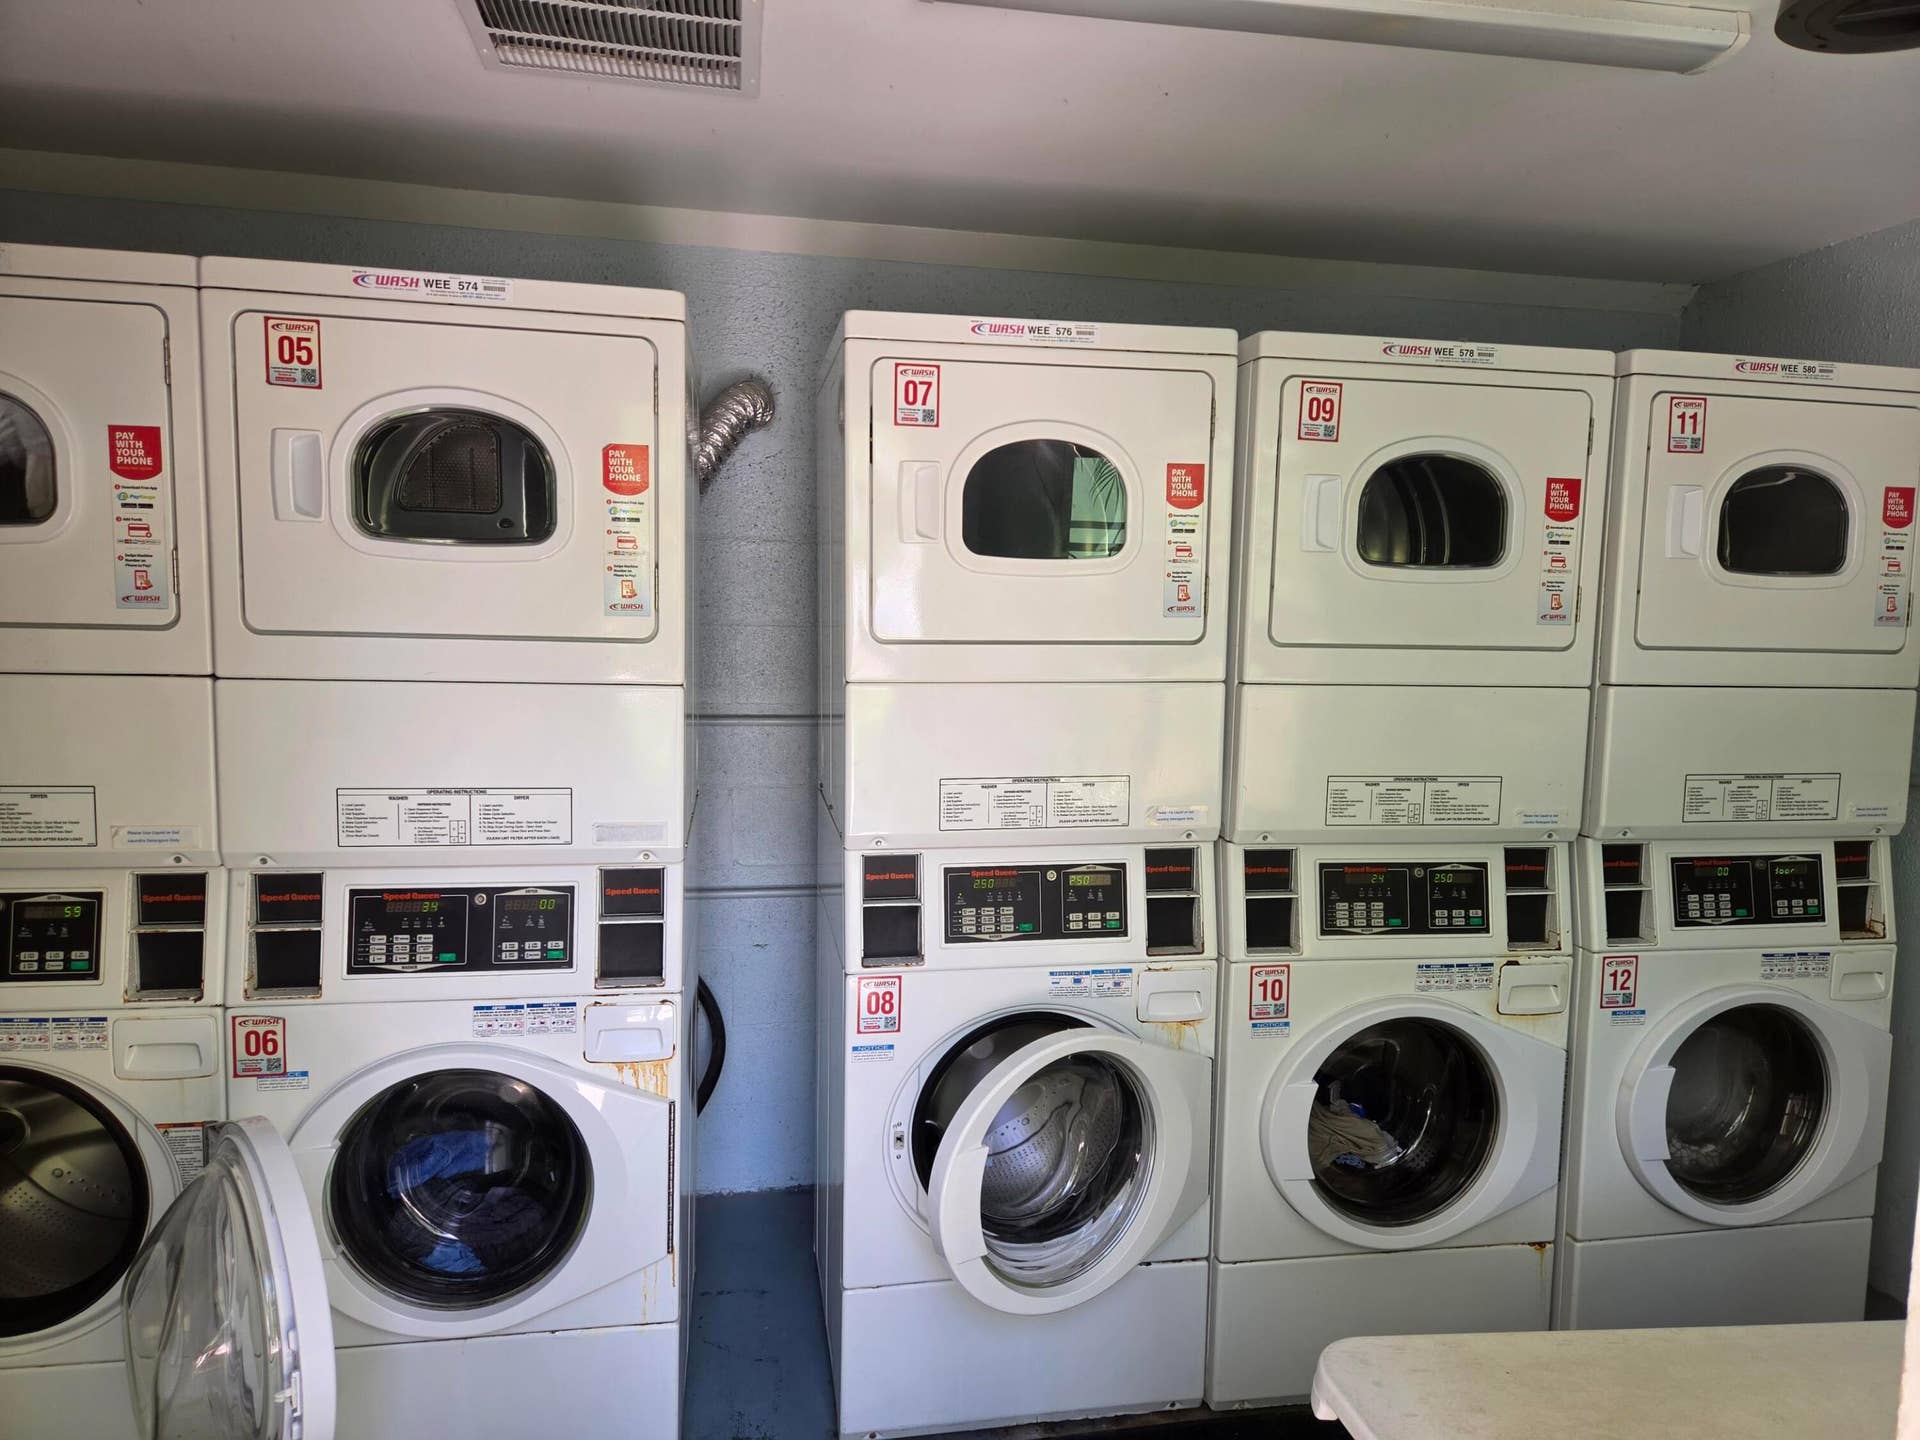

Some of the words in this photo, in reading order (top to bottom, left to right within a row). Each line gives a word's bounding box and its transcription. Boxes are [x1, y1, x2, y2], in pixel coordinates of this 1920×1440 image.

[375, 274, 419, 288] WASH
[423, 278, 450, 289] WEE
[458, 281, 478, 291] 574
[989, 323, 1024, 334] WASH
[1027, 326, 1050, 335] WEE
[1056, 327, 1072, 336] 576
[278, 335, 313, 365] 05
[1399, 345, 1432, 355] WASH
[1434, 347, 1454, 356] WEE
[1459, 349, 1474, 357] 578
[1750, 362, 1779, 371] WASH
[1781, 364, 1798, 372] WEE
[1803, 365, 1816, 373] 580
[904, 380, 932, 406] 07
[1308, 397, 1334, 422] 09
[1677, 411, 1697, 434] 11
[115, 431, 134, 440] PAY
[115, 440, 143, 449] WITH
[116, 448, 144, 457] YOUR
[608, 450, 626, 458] PAY
[117, 456, 153, 465] PHONE
[608, 458, 632, 466] WITH
[608, 465, 634, 474] YOUR
[609, 473, 641, 481] PHONE
[865, 873, 889, 881] Speed
[971, 870, 993, 878] Speed
[383, 893, 411, 902] Speed
[412, 892, 440, 900] Queen
[605, 888, 632, 896] Speed
[632, 887, 660, 895] Queen
[142, 895, 173, 903] Speed
[174, 894, 203, 902] Queen
[260, 894, 289, 903] Speed
[291, 893, 320, 901] Queen
[422, 901, 440, 912] 34
[539, 899, 556, 910] 00
[64, 906, 81, 918] 59
[1609, 969, 1631, 991] 12
[1258, 979, 1283, 1002] 10
[867, 991, 894, 1015] 08
[245, 1029, 278, 1056] 06
